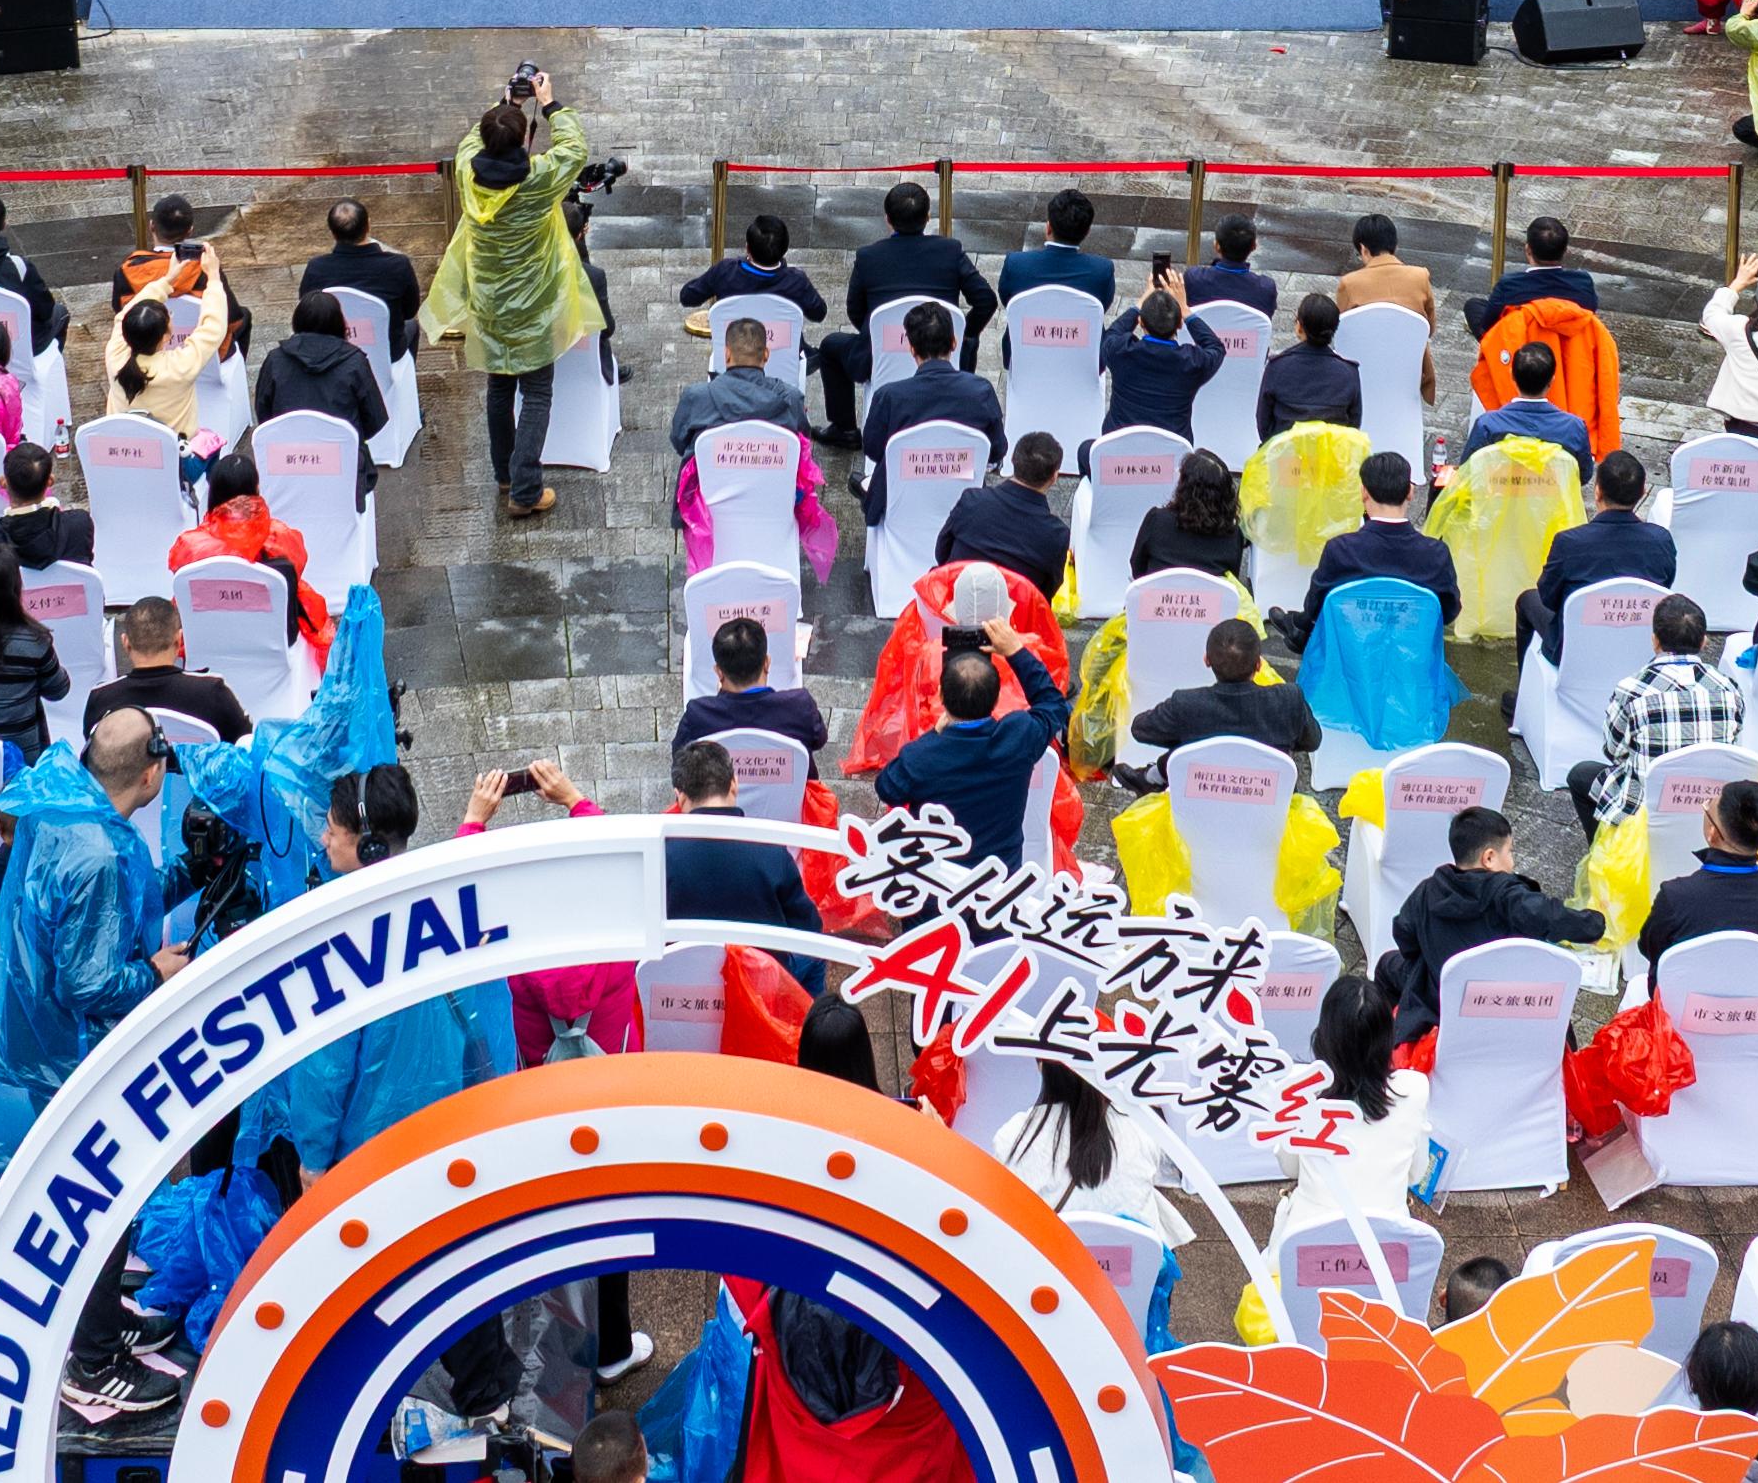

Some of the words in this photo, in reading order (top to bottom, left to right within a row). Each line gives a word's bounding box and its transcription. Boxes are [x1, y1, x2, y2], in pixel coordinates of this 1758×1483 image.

[1033, 326, 1079, 339] 黄利泽
[108, 446, 144, 458] 新华社
[723, 441, 779, 452] 市文化广电
[286, 454, 321, 464] 新华社
[717, 453, 784, 465] 体育和旅游局
[909, 452, 968, 463] 市自然资源
[914, 464, 961, 475] 和规划局
[1114, 465, 1161, 475] 市林业局
[1710, 464, 1745, 474] 市新闻
[1701, 475, 1751, 487] 传媒集团
[219, 590, 243, 600] 美团
[1161, 594, 1200, 605] 南江县
[29, 597, 66, 610] 支付宝
[1600, 598, 1651, 609] 平昌县委
[1154, 607, 1206, 618] 委宣传部
[1604, 610, 1642, 621] 宣传部
[736, 767, 781, 777] 和旅游局
[1194, 773, 1271, 786] 南江县文化广电
[1198, 782, 1264, 796] 体育和旅游局
[1400, 785, 1476, 795] 通江县文化广电
[1671, 784, 1722, 794] 平昌县文化
[1404, 793, 1468, 805] 体育和旅游局
[845, 811, 1265, 1013] 客从远方来
[1254, 986, 1313, 997] 文旅集团
[661, 998, 725, 1009] 市文旅集
[1474, 995, 1554, 1006] 市文旅集团
[122, 883, 510, 1144] FESTIVAL
[849, 923, 1354, 1157] AI上光雾红
[1316, 1259, 1370, 1272] 工作人
